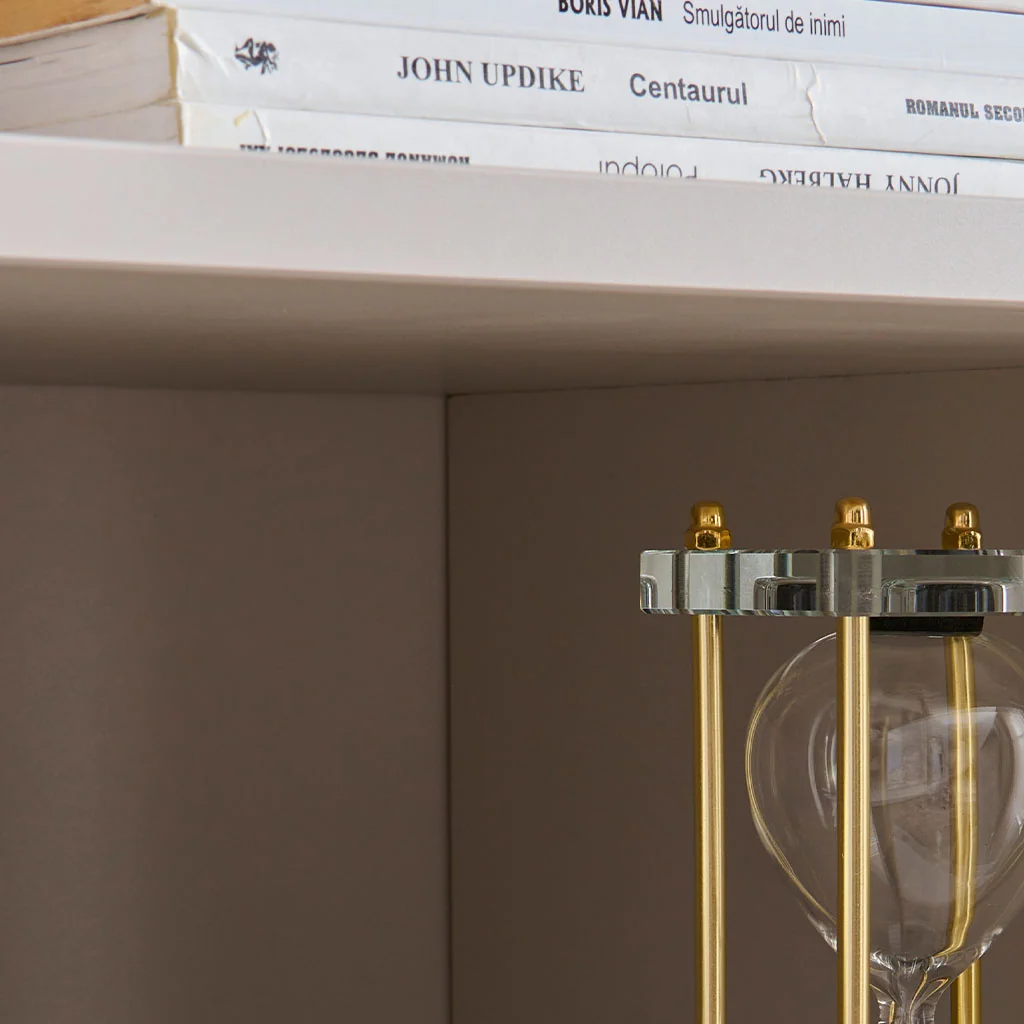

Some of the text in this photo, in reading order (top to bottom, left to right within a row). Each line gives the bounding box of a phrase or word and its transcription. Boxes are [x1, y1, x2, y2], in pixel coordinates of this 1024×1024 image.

[619, 0, 663, 21] VIAN
[683, 0, 779, 34] Smulgătorul
[785, 11, 804, 33] de
[810, 12, 846, 37] inimi
[397, 55, 473, 84] JOHN
[482, 62, 585, 93] UPDIKE
[629, 73, 748, 106] Centaurul
[905, 98, 979, 120] ROMANUL
